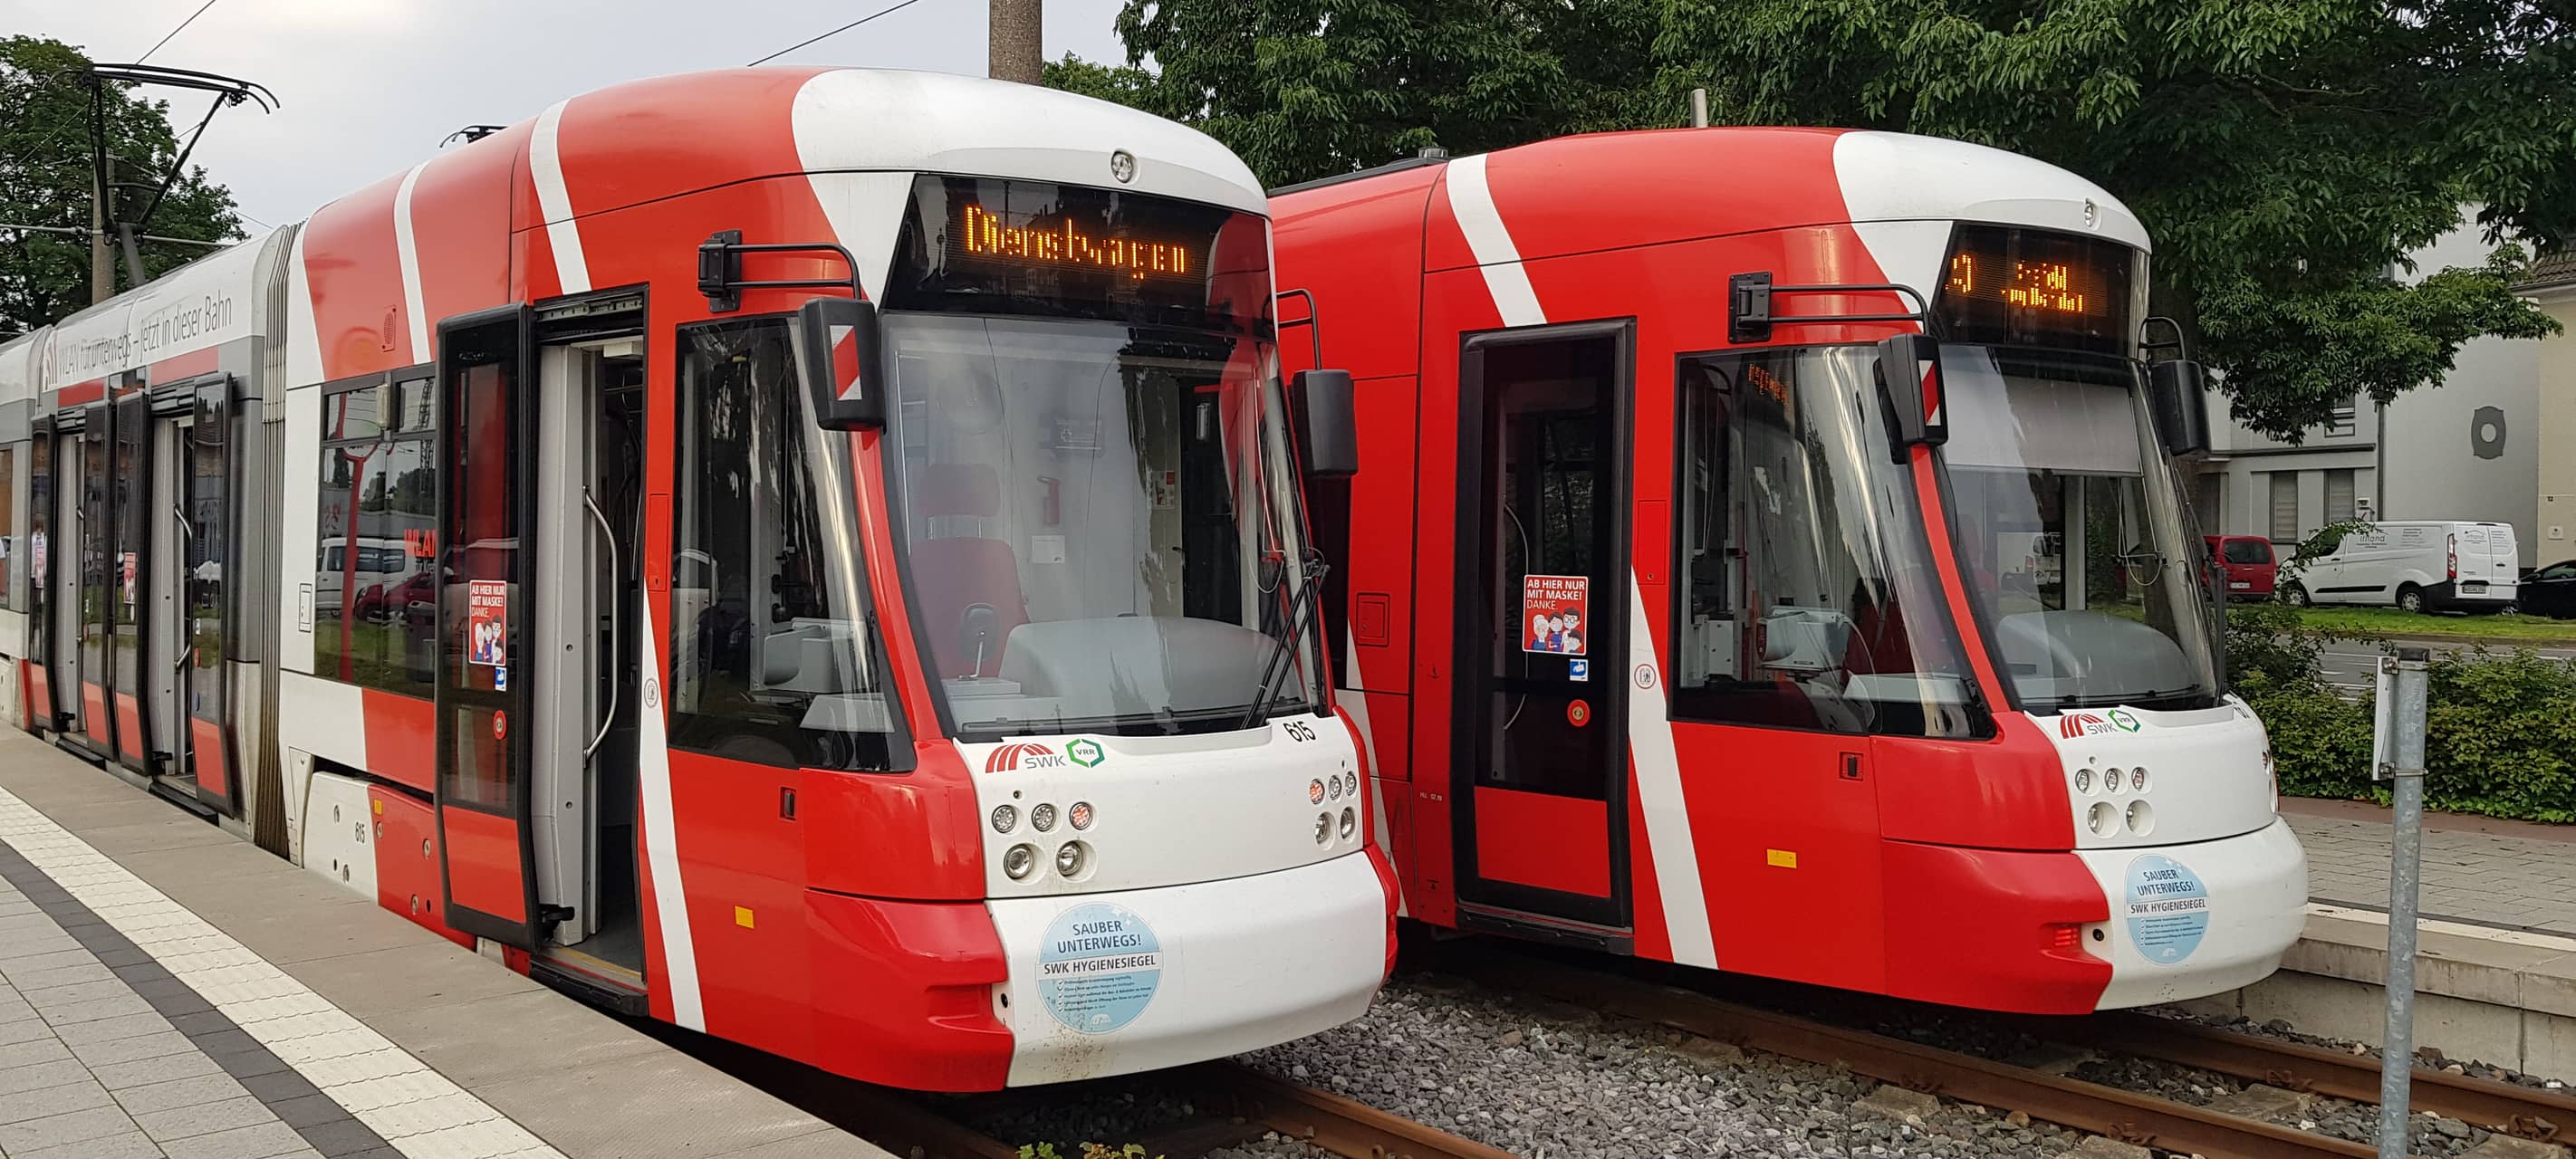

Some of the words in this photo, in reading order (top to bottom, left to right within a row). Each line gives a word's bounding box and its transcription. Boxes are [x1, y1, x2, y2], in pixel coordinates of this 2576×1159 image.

[966, 205, 1186, 281] Dienstwagen
[91, 332, 131, 368] unterwegs
[140, 317, 160, 363] jetzt
[162, 311, 170, 346] in
[172, 303, 203, 342] dieser
[205, 289, 232, 333] Bahn
[471, 584, 480, 595] AB
[480, 584, 493, 596] HIER
[493, 585, 505, 596] NUR
[1527, 579, 1540, 589] AB
[1542, 579, 1563, 589] HIER
[1564, 580, 1585, 590] NUR
[471, 595, 481, 606] MIT
[1526, 589, 1544, 599] MIT
[1546, 589, 1582, 601] MASKE!
[1526, 599, 1559, 610] DANKE.
[1283, 721, 1316, 742] 615
[2086, 723, 2119, 735] SWK
[1075, 748, 1096, 756] VRR
[1024, 755, 1066, 770] SWK
[355, 821, 366, 844] 615
[2143, 869, 2179, 882] SAUBER
[2137, 881, 2196, 896] UNTERWEGS!
[2130, 904, 2149, 914] SWK
[2151, 898, 2206, 912] HYGIENESIEGEL
[1072, 920, 1123, 936] SAUBER
[1057, 934, 1142, 953] UNTERWEGS!
[1043, 963, 1070, 974] SWK
[1072, 955, 1157, 972] HYGIENESIEGEL
